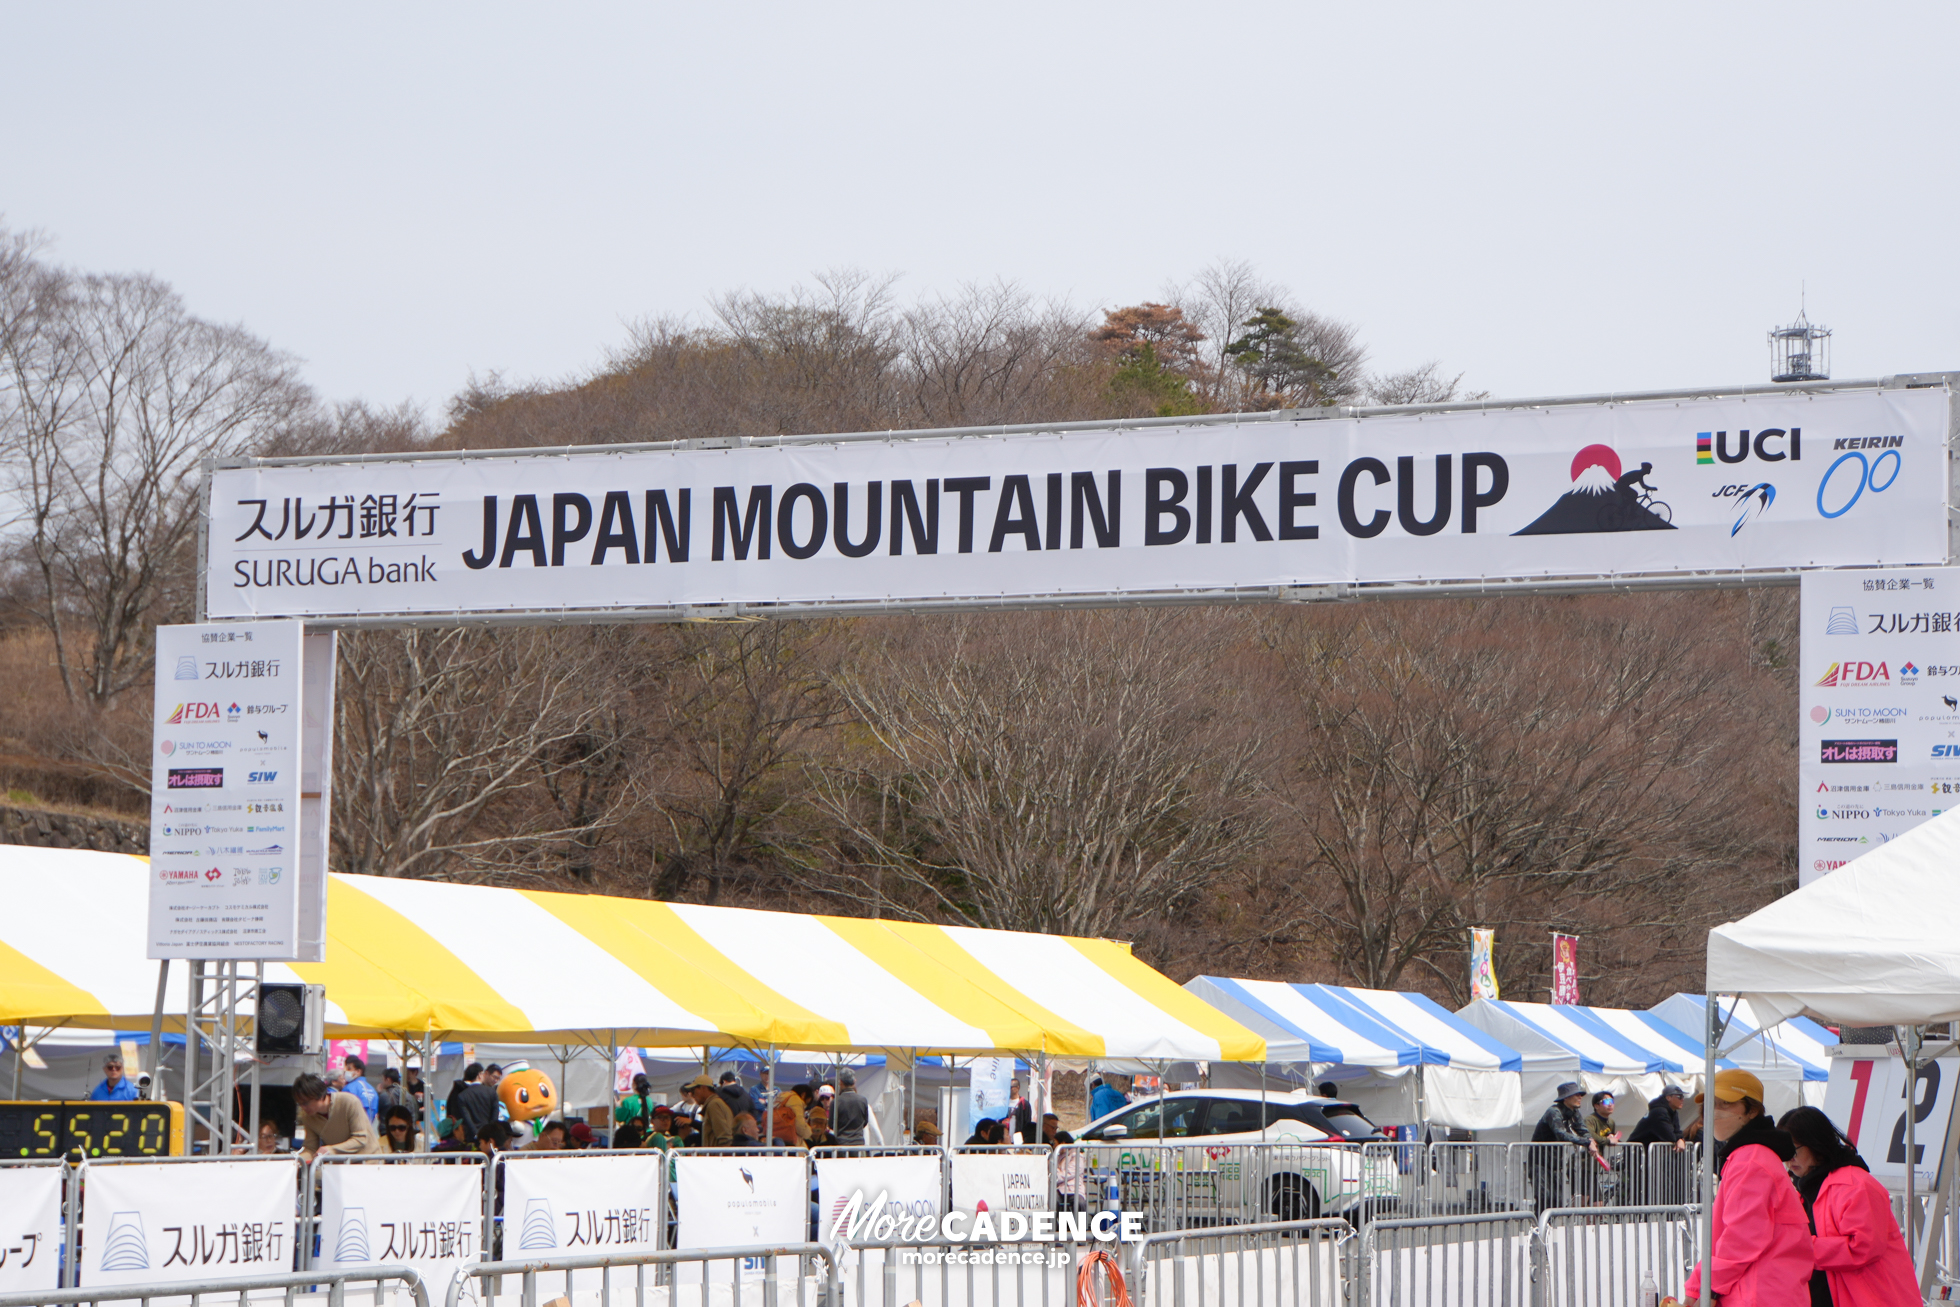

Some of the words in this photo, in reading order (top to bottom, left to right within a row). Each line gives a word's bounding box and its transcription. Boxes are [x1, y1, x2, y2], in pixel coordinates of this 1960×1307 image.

[1716, 427, 1801, 463] UCI
[1833, 435, 1904, 450] KEIRIN
[1711, 484, 1748, 497] JCF
[235, 493, 440, 542] スルガ銀行
[462, 488, 690, 569] JAPAN
[712, 470, 1121, 561] MOUNTAIN
[1145, 460, 1318, 546] BIKE
[1338, 452, 1509, 538] CUP
[234, 557, 362, 587] SURUGA
[368, 555, 437, 583] bank
[1863, 578, 1935, 591] 協賛企業一覧
[201, 631, 253, 643] 協賛企業一覧
[205, 659, 280, 680] スルガ銀行
[1841, 661, 1890, 681] FDA
[185, 702, 220, 719] FDA
[247, 704, 288, 715] 鈴与グループ
[1835, 708, 1856, 718] SUN
[1858, 708, 1871, 718] TO
[1873, 708, 1907, 718] MOON
[206, 741, 232, 749] MOON
[247, 771, 278, 782] SIW
[1832, 809, 1870, 820] NIPPO
[1882, 809, 1905, 817] Tokyo
[1907, 808, 1927, 816] Yuka
[174, 828, 202, 836] NIPPO
[169, 870, 199, 880] YAMAHA
[1847, 1060, 1875, 1150] 1
[1886, 1058, 1941, 1165] 2
[1007, 1173, 1031, 1189] JAPAN
[1008, 1194, 1044, 1210] MOUNTAIN
[565, 1207, 650, 1248] スルガ銀行
[162, 1221, 284, 1268] スルガ銀行
[380, 1220, 472, 1261] スルガ銀行
[0, 1232, 42, 1269] ープ
